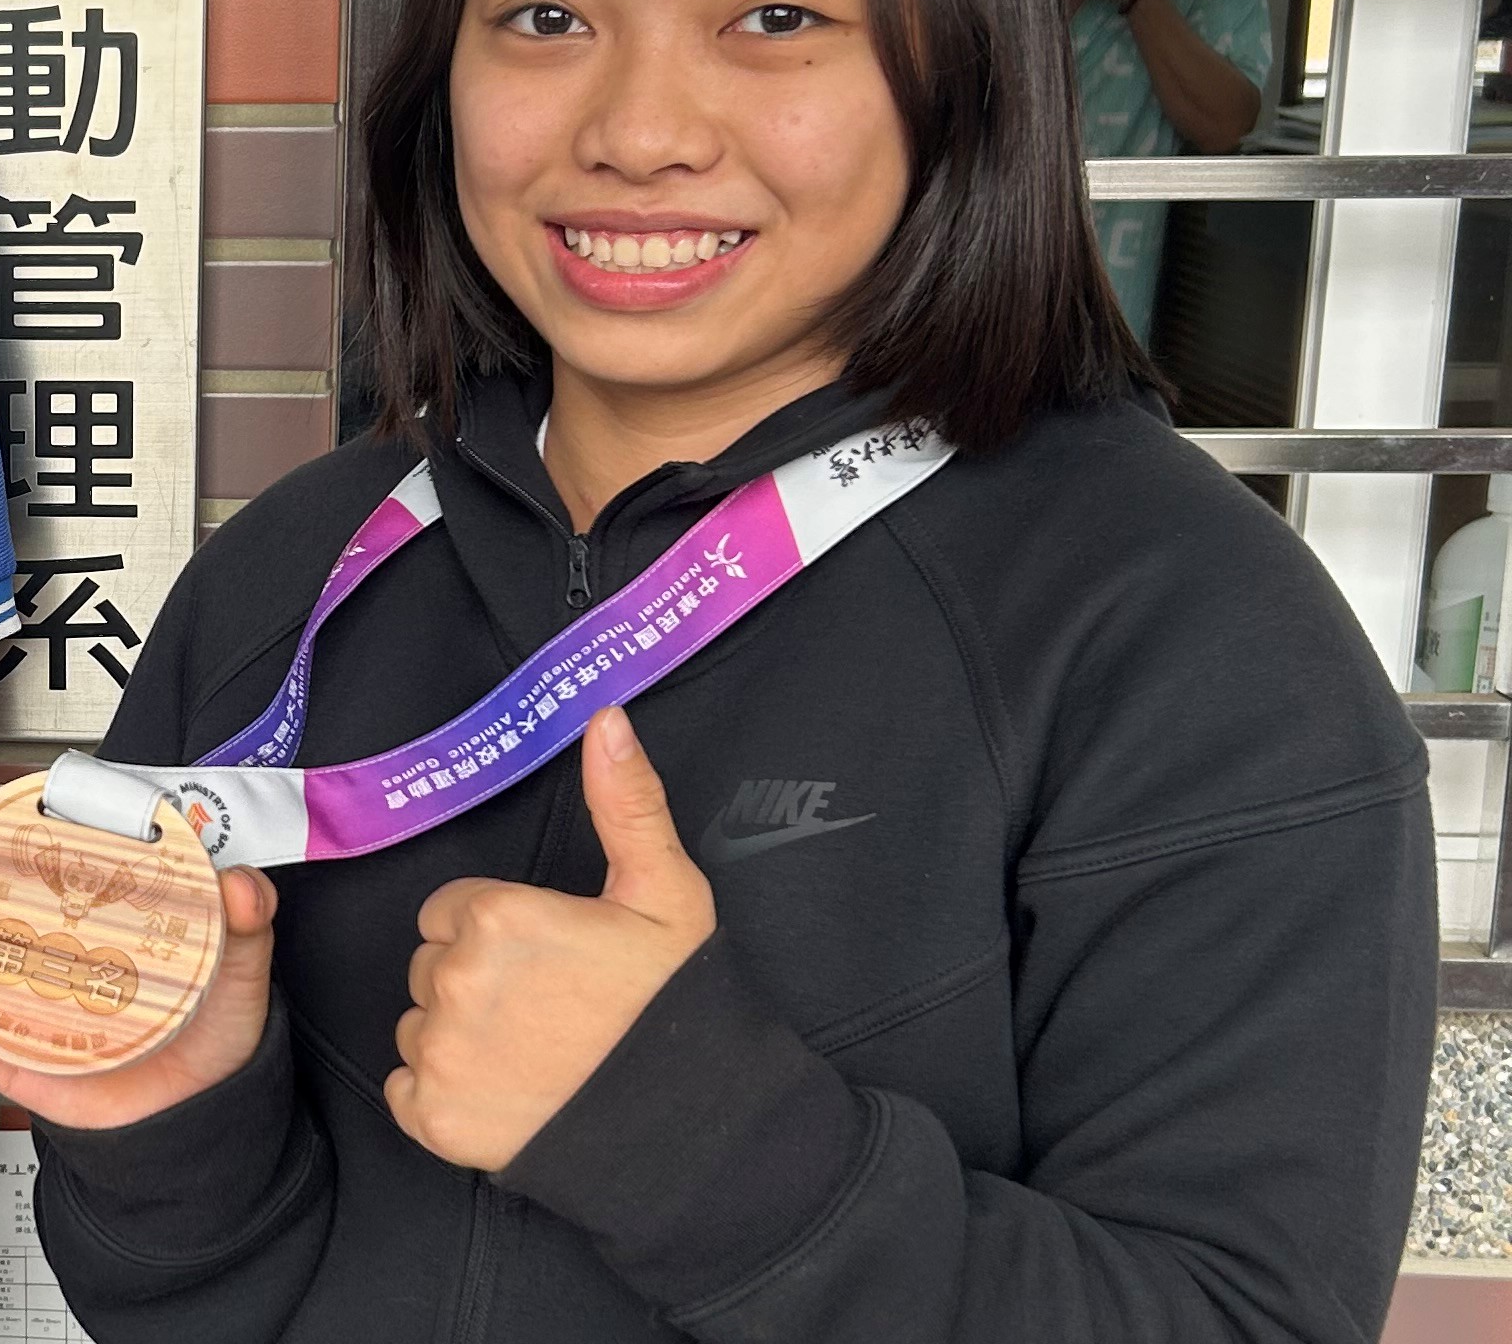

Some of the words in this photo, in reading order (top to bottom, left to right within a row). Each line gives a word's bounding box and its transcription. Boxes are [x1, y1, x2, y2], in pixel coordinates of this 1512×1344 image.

[638, 562, 702, 622] National
[517, 621, 633, 709] Intercollegiate
[385, 575, 719, 809] 中華民國115年全國大專校院運動會
[447, 712, 512, 759] Athletic
[381, 757, 441, 789] Games
[179, 781, 227, 811] MINISTRY
[221, 814, 231, 831] OF
[724, 779, 835, 825] NIKE
[138, 937, 180, 962] 女子
